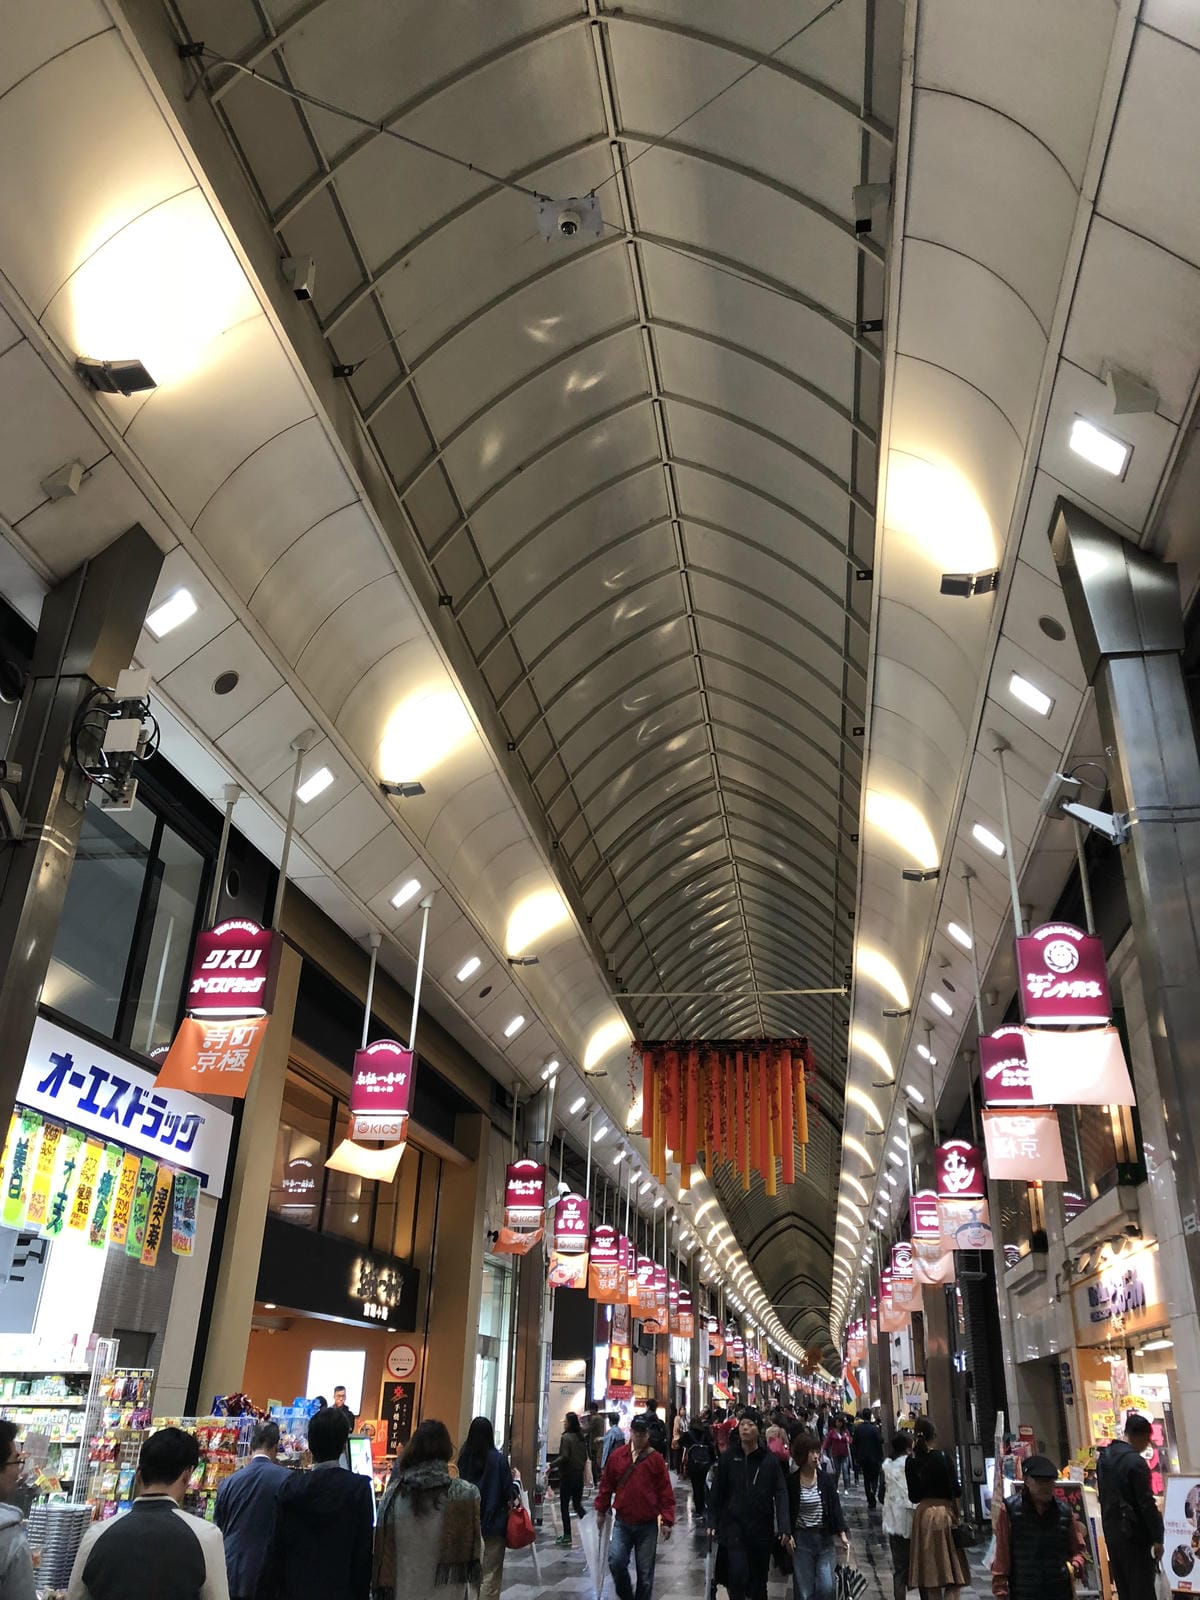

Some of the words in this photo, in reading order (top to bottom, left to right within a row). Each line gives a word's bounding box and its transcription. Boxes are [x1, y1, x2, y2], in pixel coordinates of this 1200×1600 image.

[214, 921, 259, 936] TERAMACHI
[202, 950, 262, 969] クスリ
[190, 977, 266, 993] オーエスドラッグ
[203, 1026, 258, 1049] 寺町
[191, 1049, 250, 1072] 京極
[36, 1052, 206, 1153] オーエスドラッグ
[370, 1124, 398, 1134] KICS
